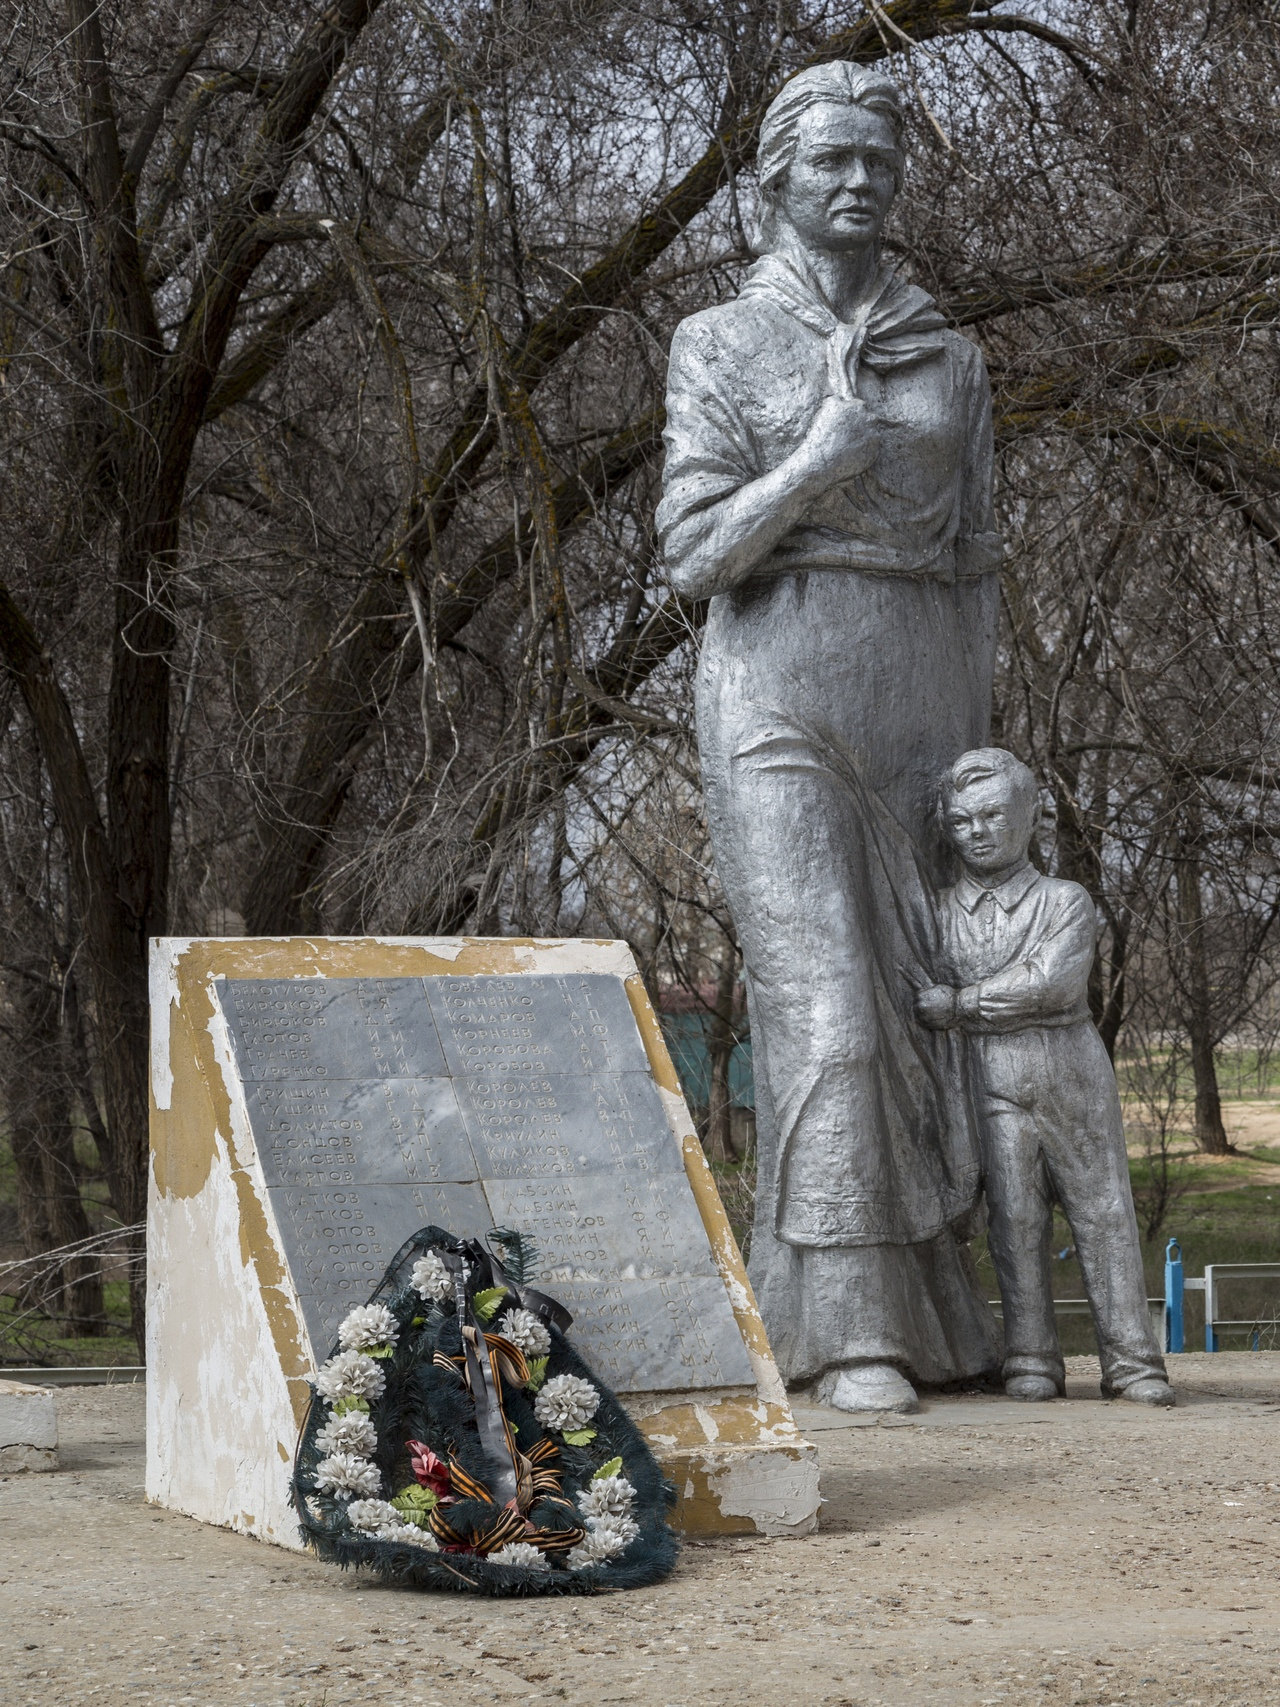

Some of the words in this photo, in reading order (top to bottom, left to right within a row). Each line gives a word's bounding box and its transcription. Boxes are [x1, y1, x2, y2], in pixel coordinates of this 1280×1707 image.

[230, 984, 328, 996] БЕЛОГУРОВ
[437, 979, 516, 992] КОВАЛЕВ
[234, 1000, 323, 1012] БИРЮКОВ
[443, 996, 533, 1008] КОЛЧЕНКО
[239, 1016, 327, 1028] БИРЮКОВ
[448, 1011, 535, 1024] КОМАРОВ
[242, 1032, 312, 1044] ГЛОТОВ
[452, 1027, 532, 1040] КОРНЕЕВ
[246, 1048, 309, 1060] ГРАЧЕВ
[458, 1043, 554, 1056] КОРОБОВА
[251, 1065, 328, 1077] ГУРЕНКО
[462, 1059, 545, 1072] КОРОБОВ
[257, 1087, 329, 1099] ГРИШИН
[467, 1081, 552, 1094] КОРОЛЕВ
[472, 1097, 557, 1110] КОРОЛЕВ
[266, 1119, 363, 1132] ДОЛМАТОВ
[476, 1113, 562, 1126] КОРОЛЕВ
[480, 1129, 559, 1142] КРИУЛИН
[271, 1136, 353, 1149] ДОНЦОВ
[487, 1146, 569, 1159] КУЛИКОВ
[272, 1153, 356, 1166] ЕЛИСЕЕВ
[492, 1163, 575, 1176] КУЛИКОВ
[277, 1170, 353, 1183] КАРПОВ
[503, 1185, 573, 1199] ЛАБЗИН
[285, 1192, 359, 1206] КАТКОВ
[507, 1201, 578, 1214] ЛАБЗИН
[290, 1208, 364, 1222] КАТКОВ
[512, 1216, 605, 1230] ЛЕГЕНЬКОВ
[294, 1226, 376, 1239] КЛОПОВ
[294, 1243, 383, 1256] КЛОПОВ
[538, 1250, 608, 1265] ОБАНОВ
[541, 1267, 620, 1281] ОМАКИН
